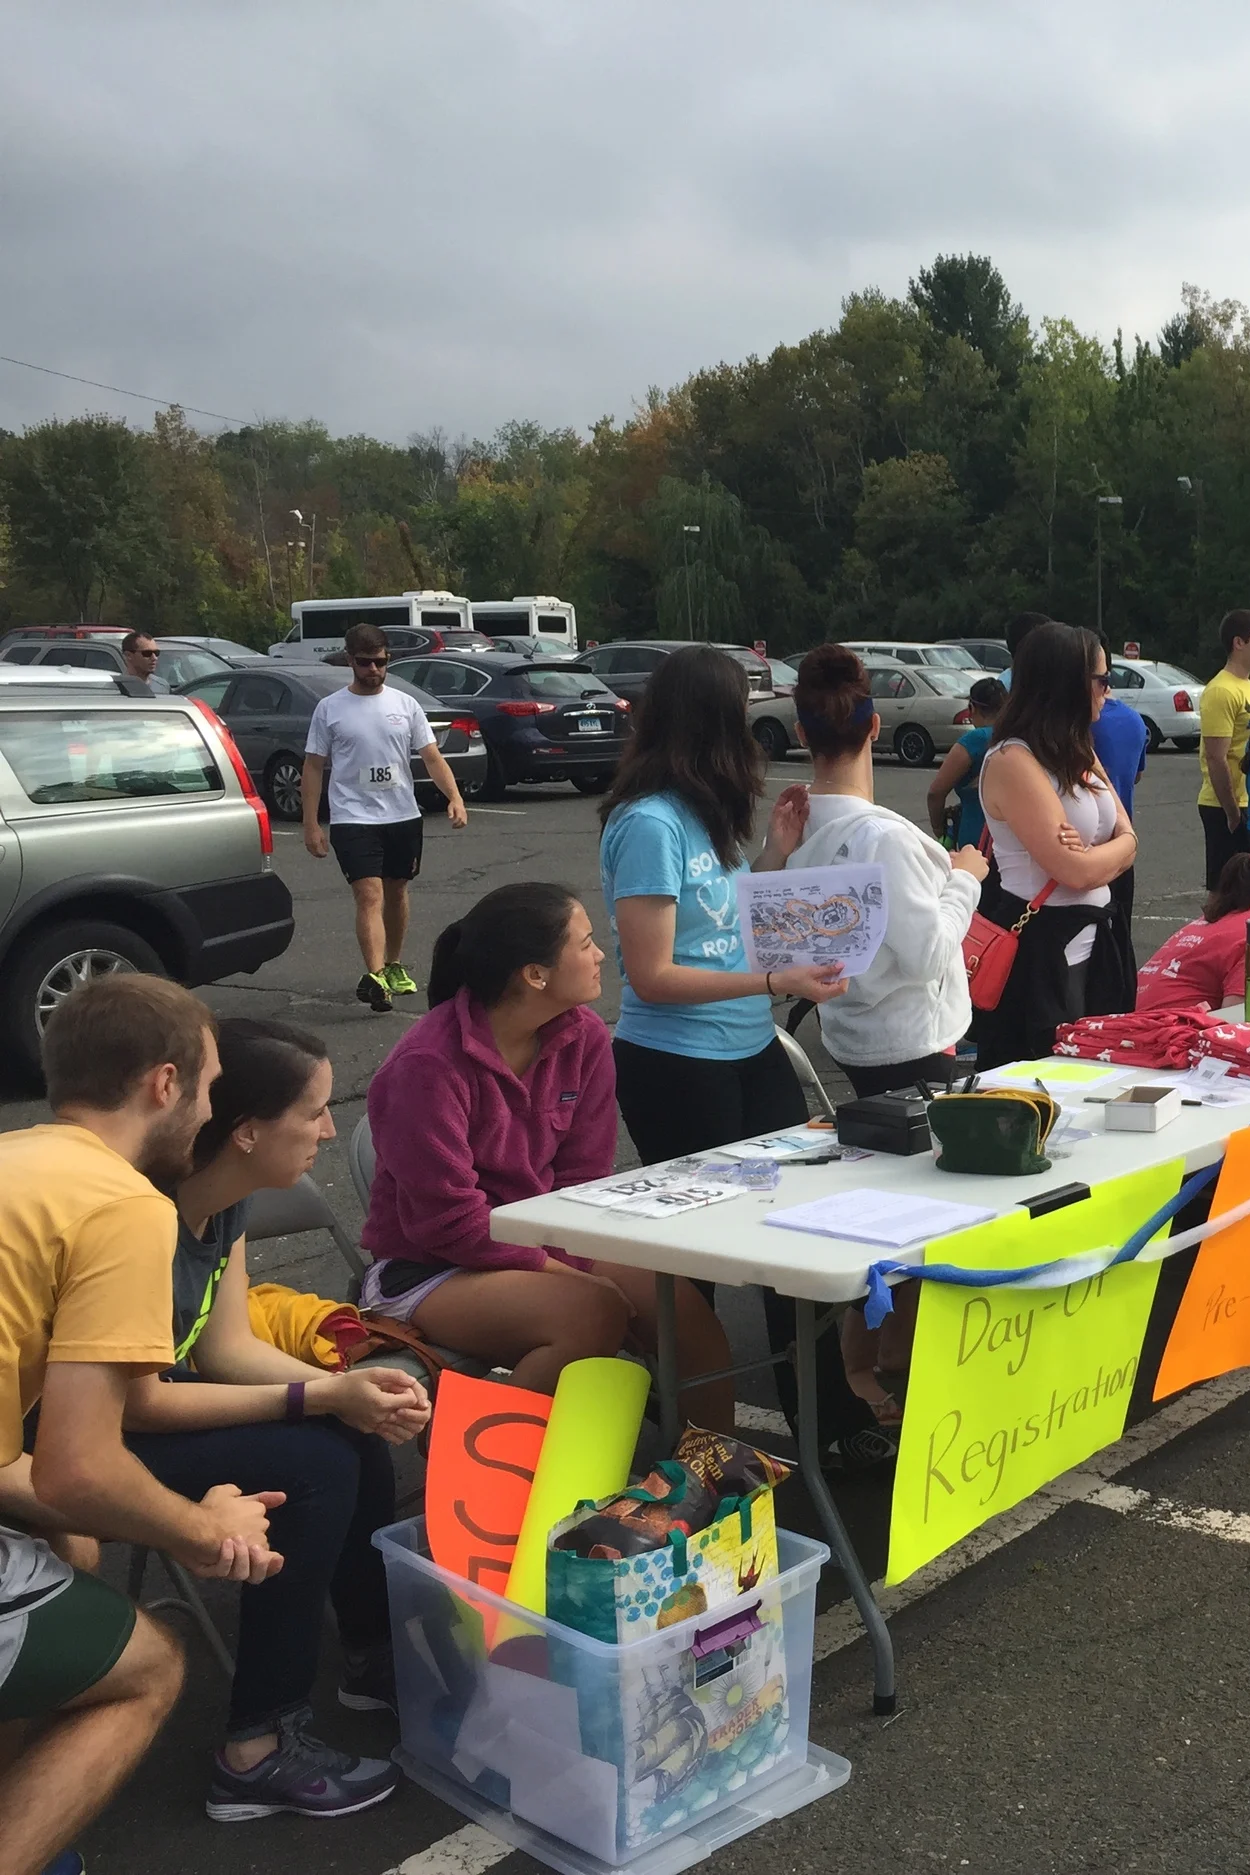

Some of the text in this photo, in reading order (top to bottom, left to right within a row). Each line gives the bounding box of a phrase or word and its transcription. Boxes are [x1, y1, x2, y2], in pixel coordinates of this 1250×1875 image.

[369, 766, 392, 783] 185
[714, 1442, 734, 1463] and
[924, 1356, 1138, 1524] Registration
[705, 1447, 724, 1481] Bean
